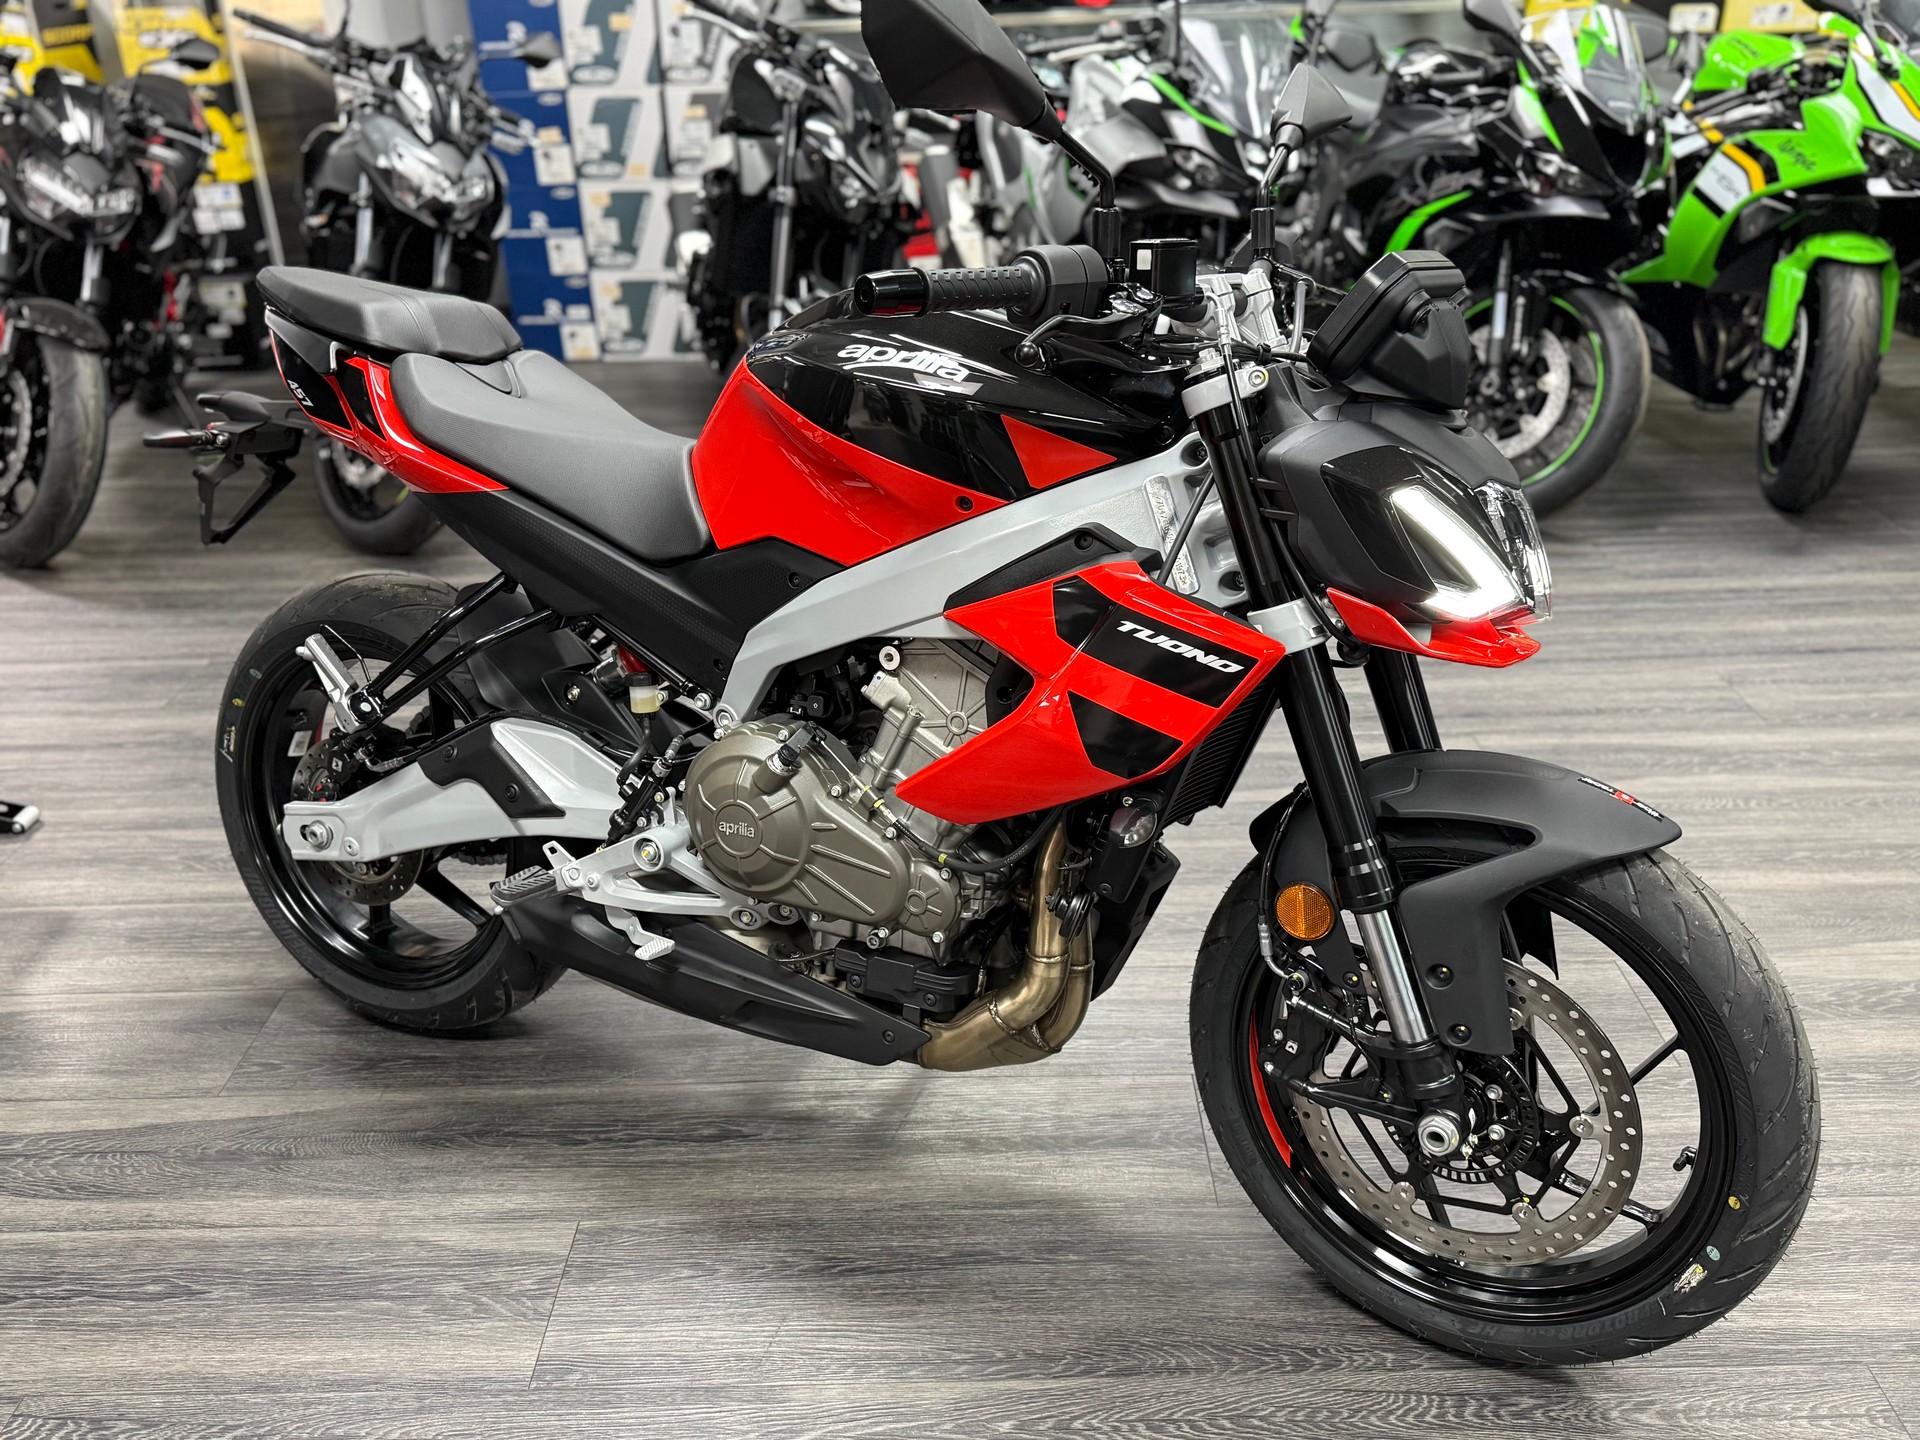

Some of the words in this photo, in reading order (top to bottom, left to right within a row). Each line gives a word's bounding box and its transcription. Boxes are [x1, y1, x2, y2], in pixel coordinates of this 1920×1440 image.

[287, 379, 314, 407] 457
[1116, 620, 1245, 673] TUONO
[718, 821, 755, 838] aprilia
